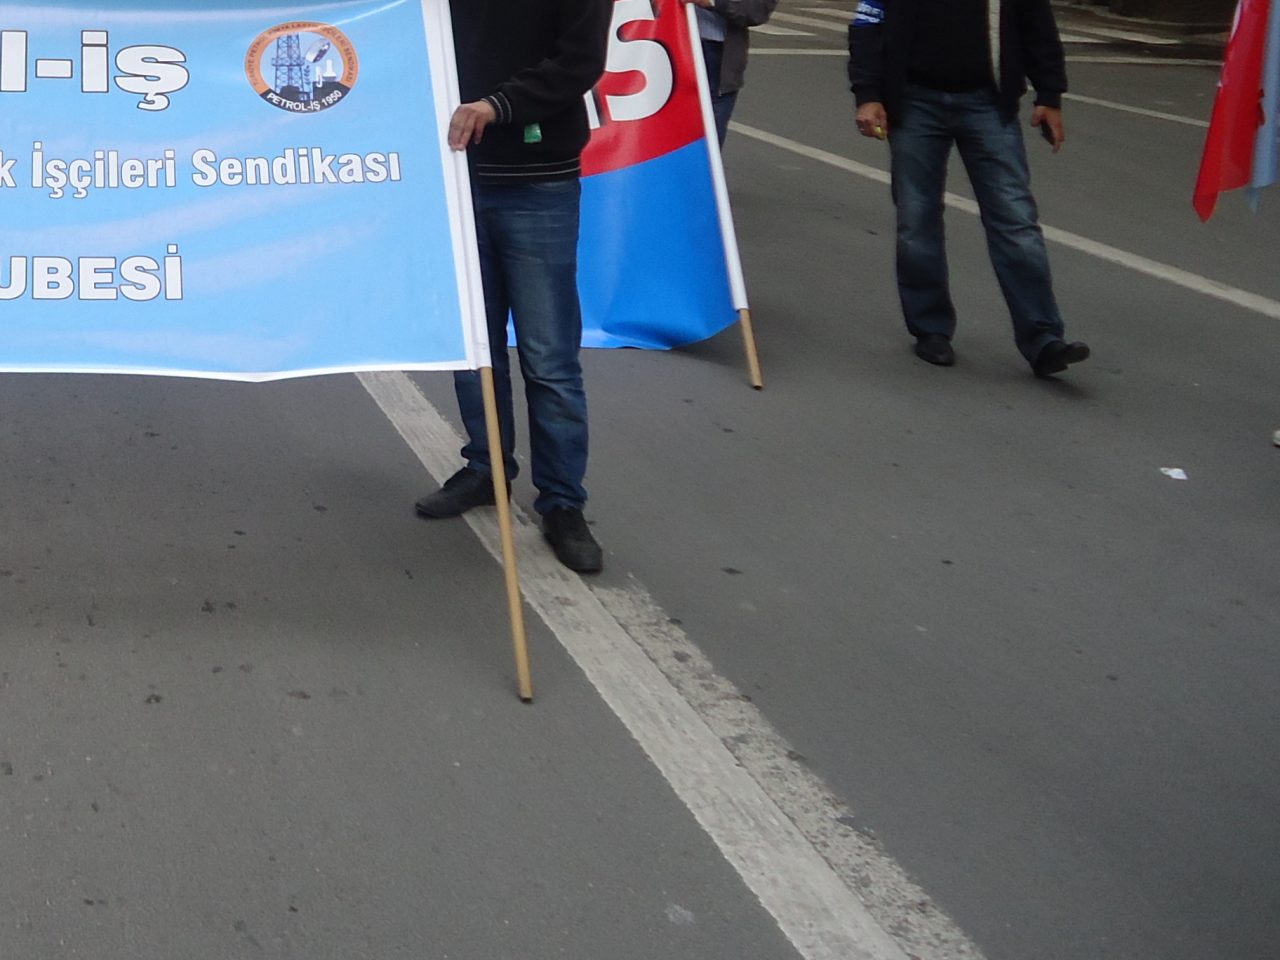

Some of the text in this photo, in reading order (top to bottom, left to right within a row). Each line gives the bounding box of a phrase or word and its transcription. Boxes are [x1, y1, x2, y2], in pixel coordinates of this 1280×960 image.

[321, 90, 342, 106] 1950
[31, 141, 176, 199] İşçileri
[191, 147, 402, 189] Sendikası
